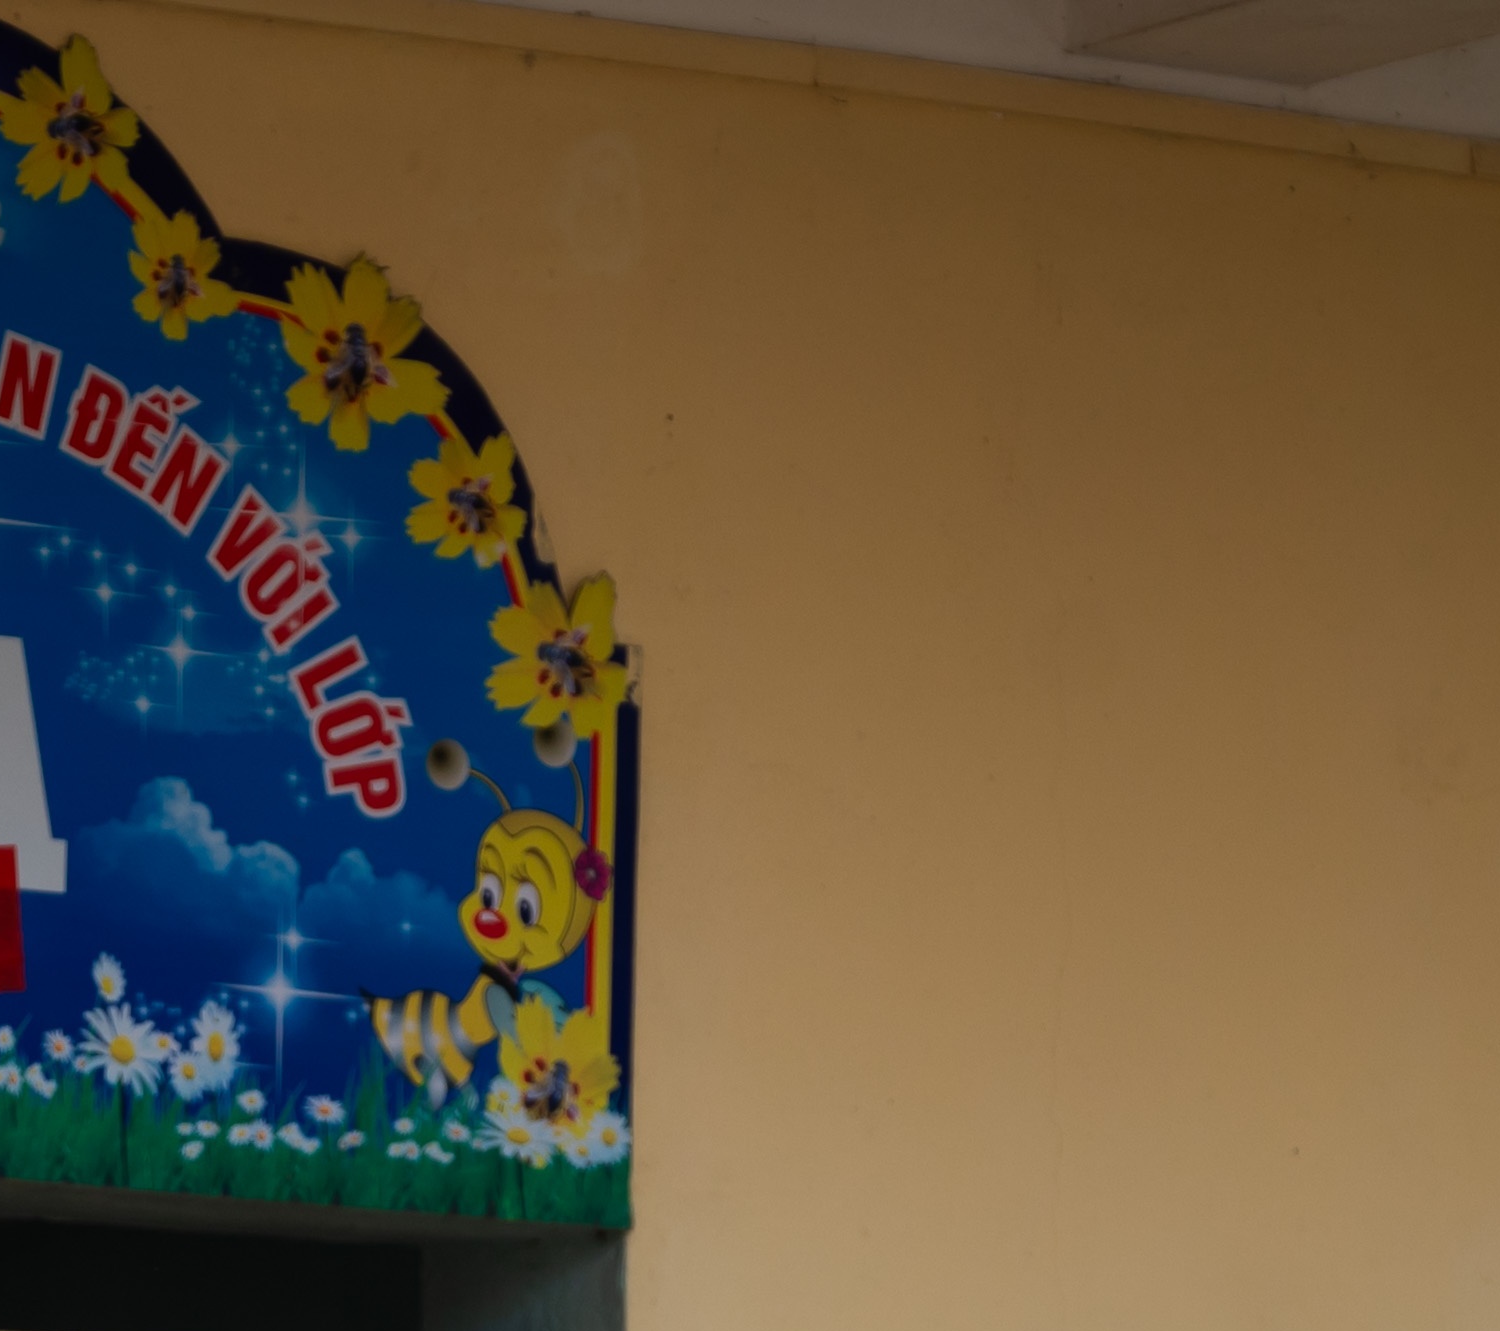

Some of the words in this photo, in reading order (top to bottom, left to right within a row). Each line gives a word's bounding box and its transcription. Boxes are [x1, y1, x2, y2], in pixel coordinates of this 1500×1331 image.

[61, 370, 226, 531] ĐẾN
[210, 490, 336, 651] VỚI
[292, 641, 408, 816] LỚP
